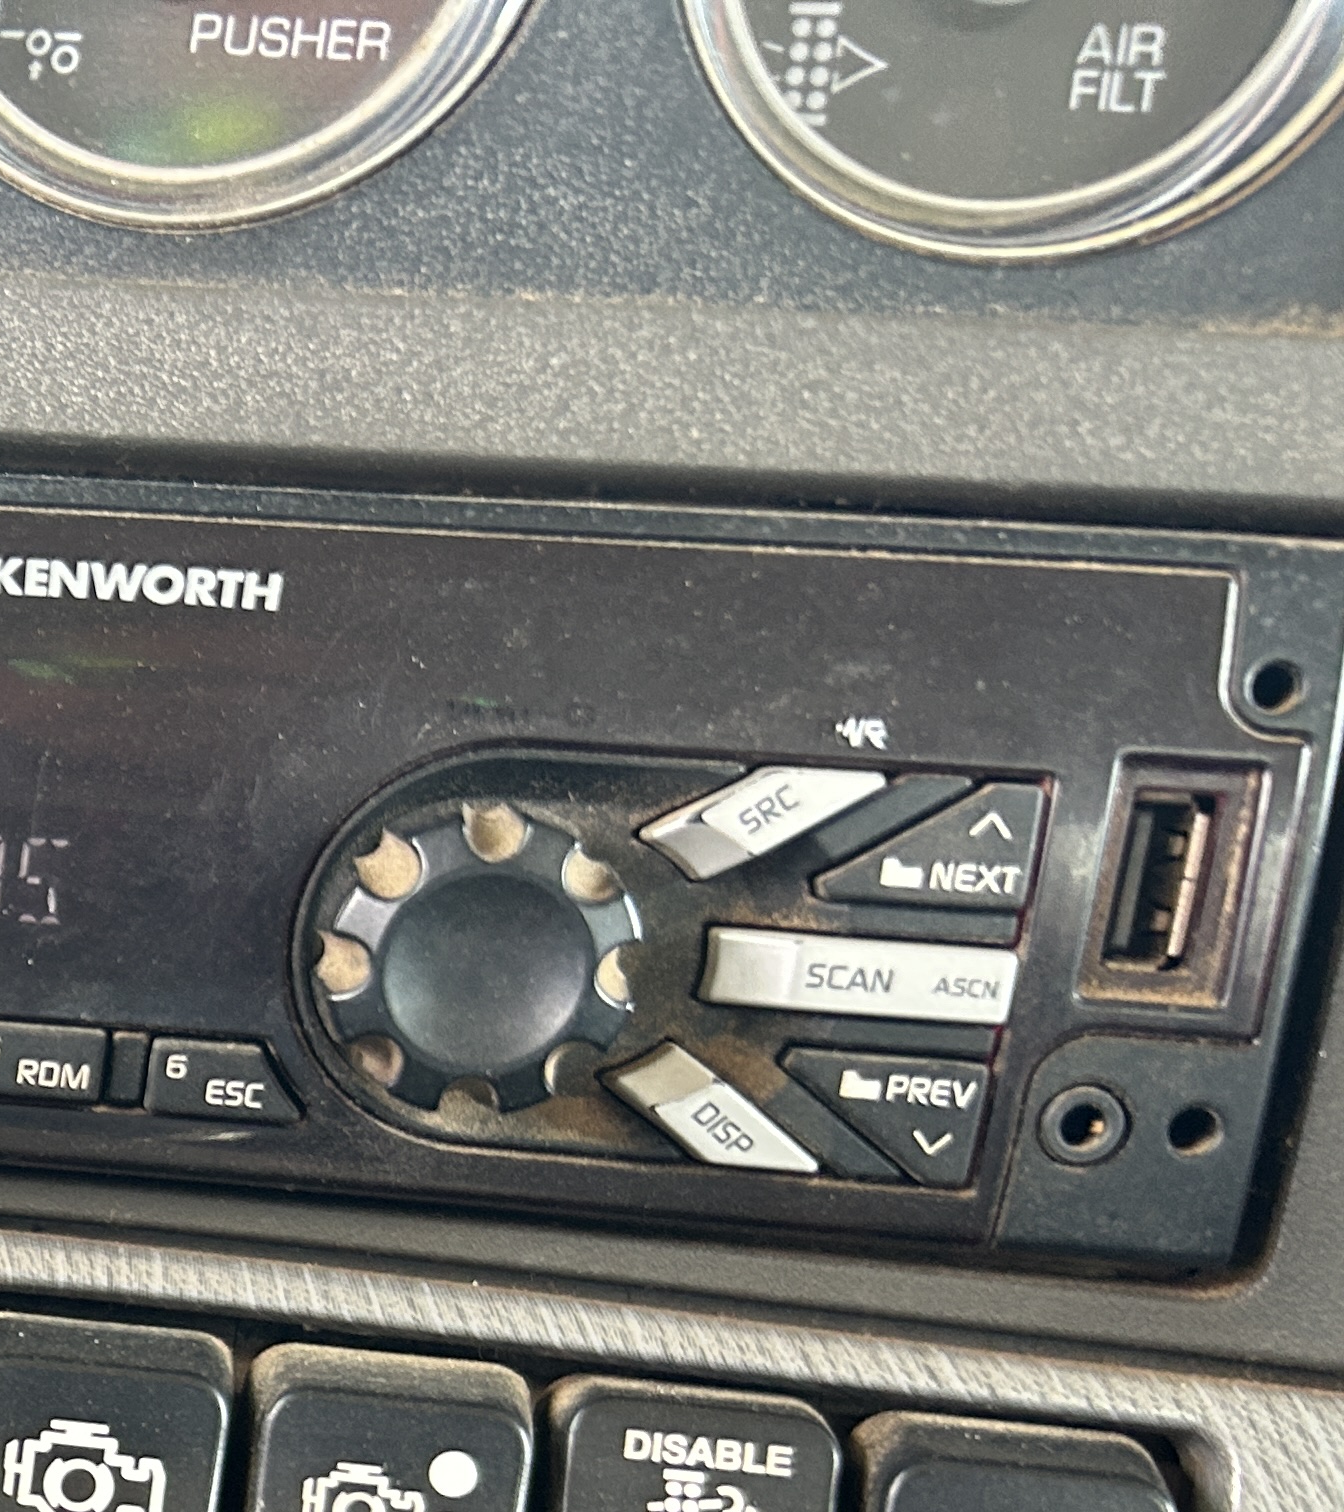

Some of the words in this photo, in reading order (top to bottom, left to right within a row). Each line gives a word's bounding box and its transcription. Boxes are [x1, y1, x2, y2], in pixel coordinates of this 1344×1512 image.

[190, 12, 391, 61] PUSHER
[1076, 22, 1166, 68] AIR
[1069, 68, 1167, 113] FILT
[739, 783, 800, 835] SRC
[927, 861, 1020, 895] NEXT
[805, 962, 895, 994] SCAN
[931, 976, 1001, 999] ASCN
[16, 1058, 91, 1090] RDM
[165, 1054, 189, 1080] 6
[205, 1078, 265, 1109] ESC
[886, 1074, 975, 1110] PREV
[691, 1101, 754, 1152] DISP
[622, 1428, 794, 1477] DISABLE
